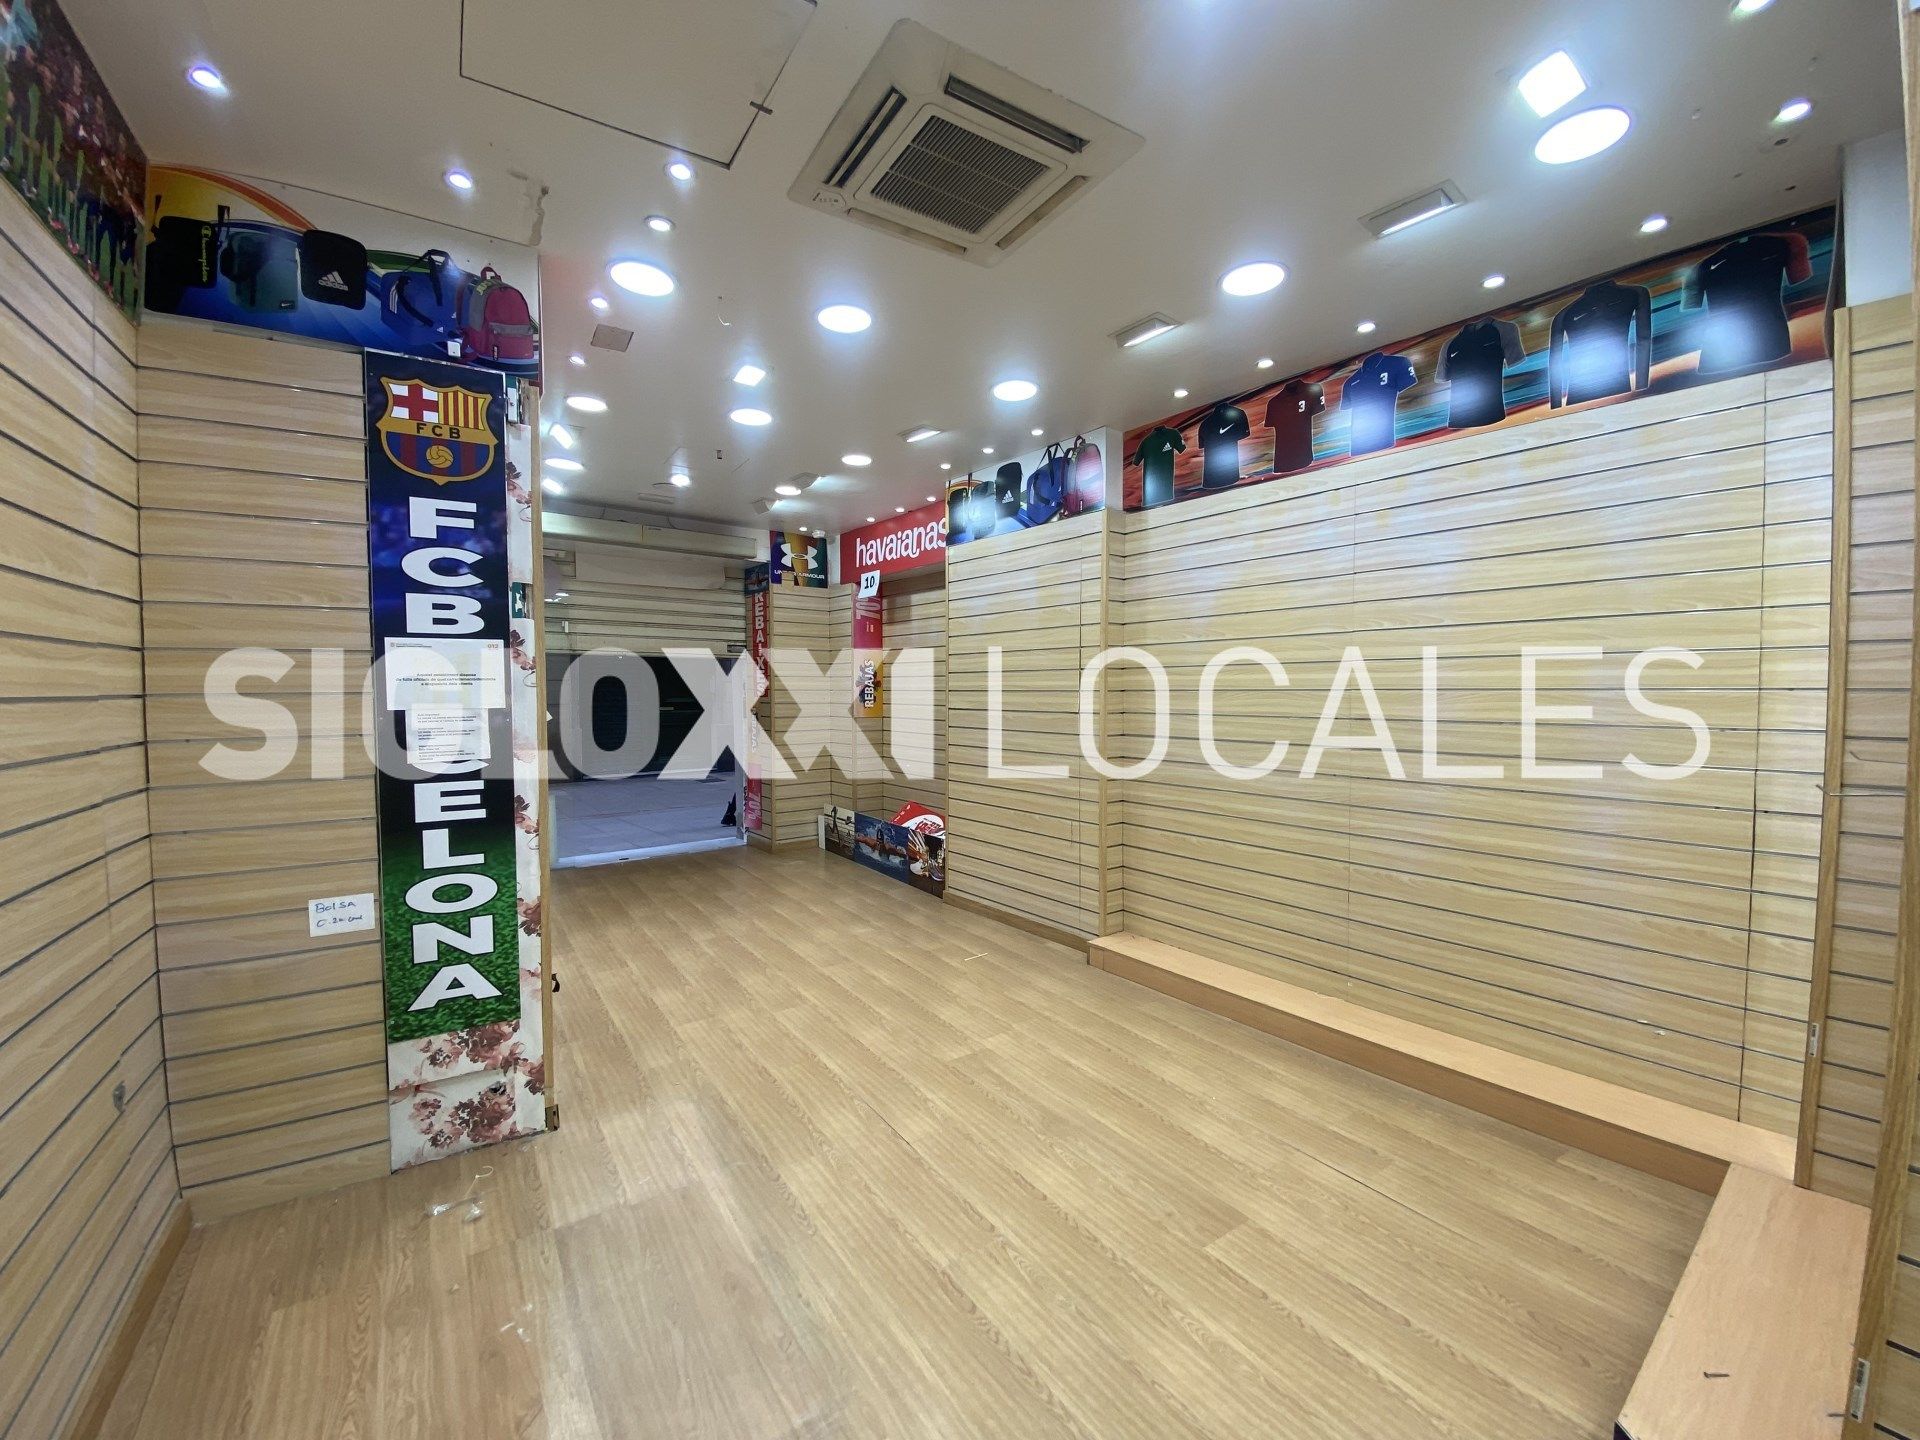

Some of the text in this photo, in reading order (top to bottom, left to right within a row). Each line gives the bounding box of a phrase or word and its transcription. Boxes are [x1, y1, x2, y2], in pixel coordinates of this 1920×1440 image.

[1379, 372, 1389, 386] 3
[1298, 400, 1306, 413] 3
[416, 423, 461, 440] FCB
[856, 517, 947, 568] havaianas
[863, 575, 876, 590] 10
[864, 659, 875, 708] REBAJAS
[748, 792, 762, 820] 70%
